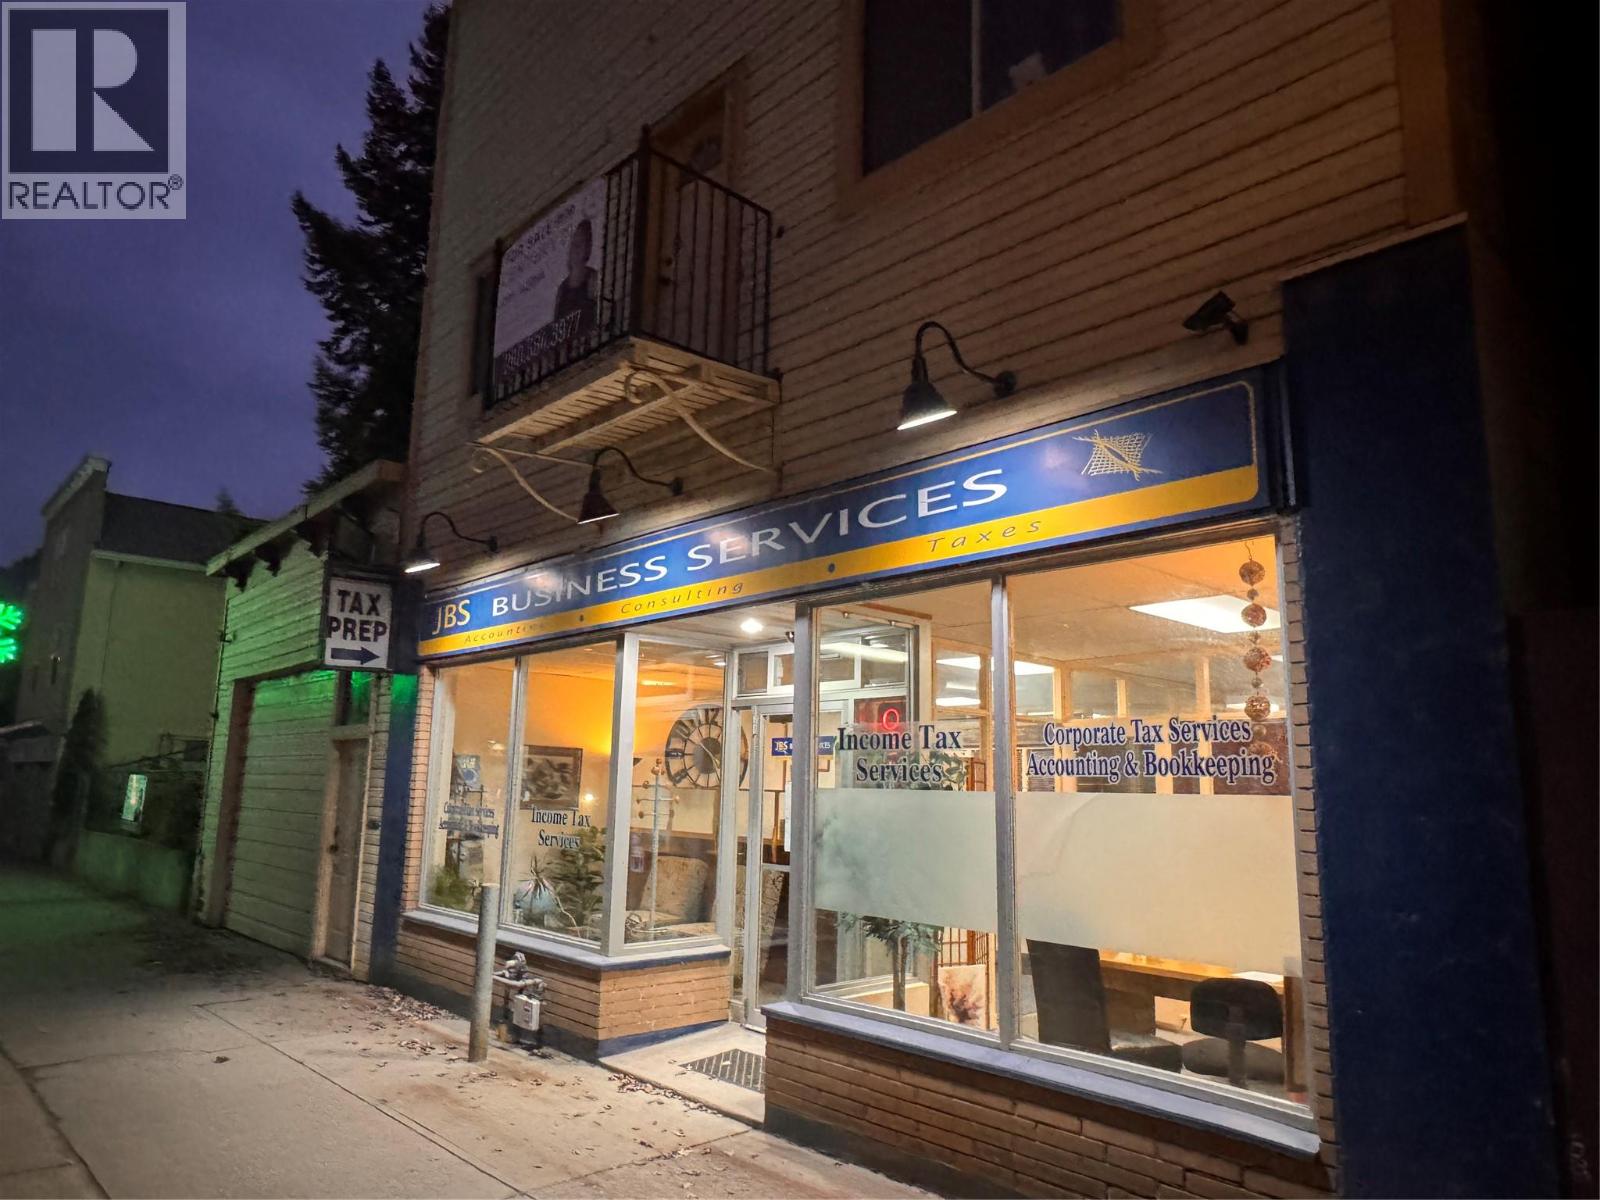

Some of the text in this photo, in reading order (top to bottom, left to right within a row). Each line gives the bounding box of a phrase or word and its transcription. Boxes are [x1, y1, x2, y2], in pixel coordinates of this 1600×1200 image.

[432, 469, 1008, 635] JBS BUSINESS SERVICES
[621, 581, 744, 614] Consulting
[928, 519, 1041, 553] Taxes
[338, 589, 381, 616] TAX
[327, 615, 387, 642] PREP
[837, 724, 961, 750] Income Tax
[1044, 715, 1251, 750] Corporate Tax Services
[856, 757, 943, 782] Services
[1027, 749, 1275, 784] Accounting & Bookkeeping
[531, 806, 592, 828] Income Tax
[538, 829, 581, 849] Services
